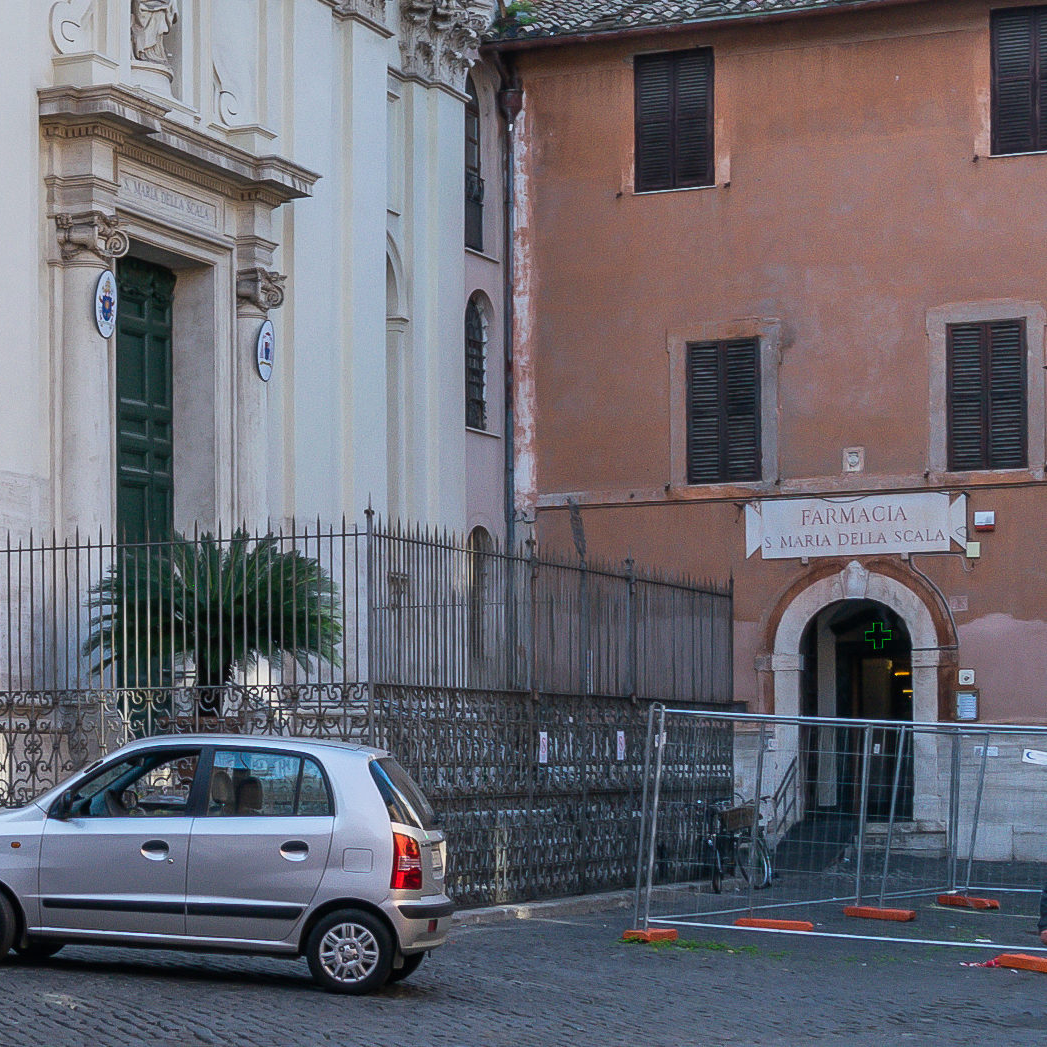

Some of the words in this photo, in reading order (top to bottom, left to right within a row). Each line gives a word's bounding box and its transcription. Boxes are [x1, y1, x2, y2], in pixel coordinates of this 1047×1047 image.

[134, 180, 159, 201] MARIA
[161, 190, 185, 211] DELLA
[186, 200, 209, 220] SCALA
[801, 505, 908, 526] FARMACIA
[780, 534, 831, 549] MARIA
[838, 532, 887, 546] DELLA
[894, 528, 946, 544] SCALA
